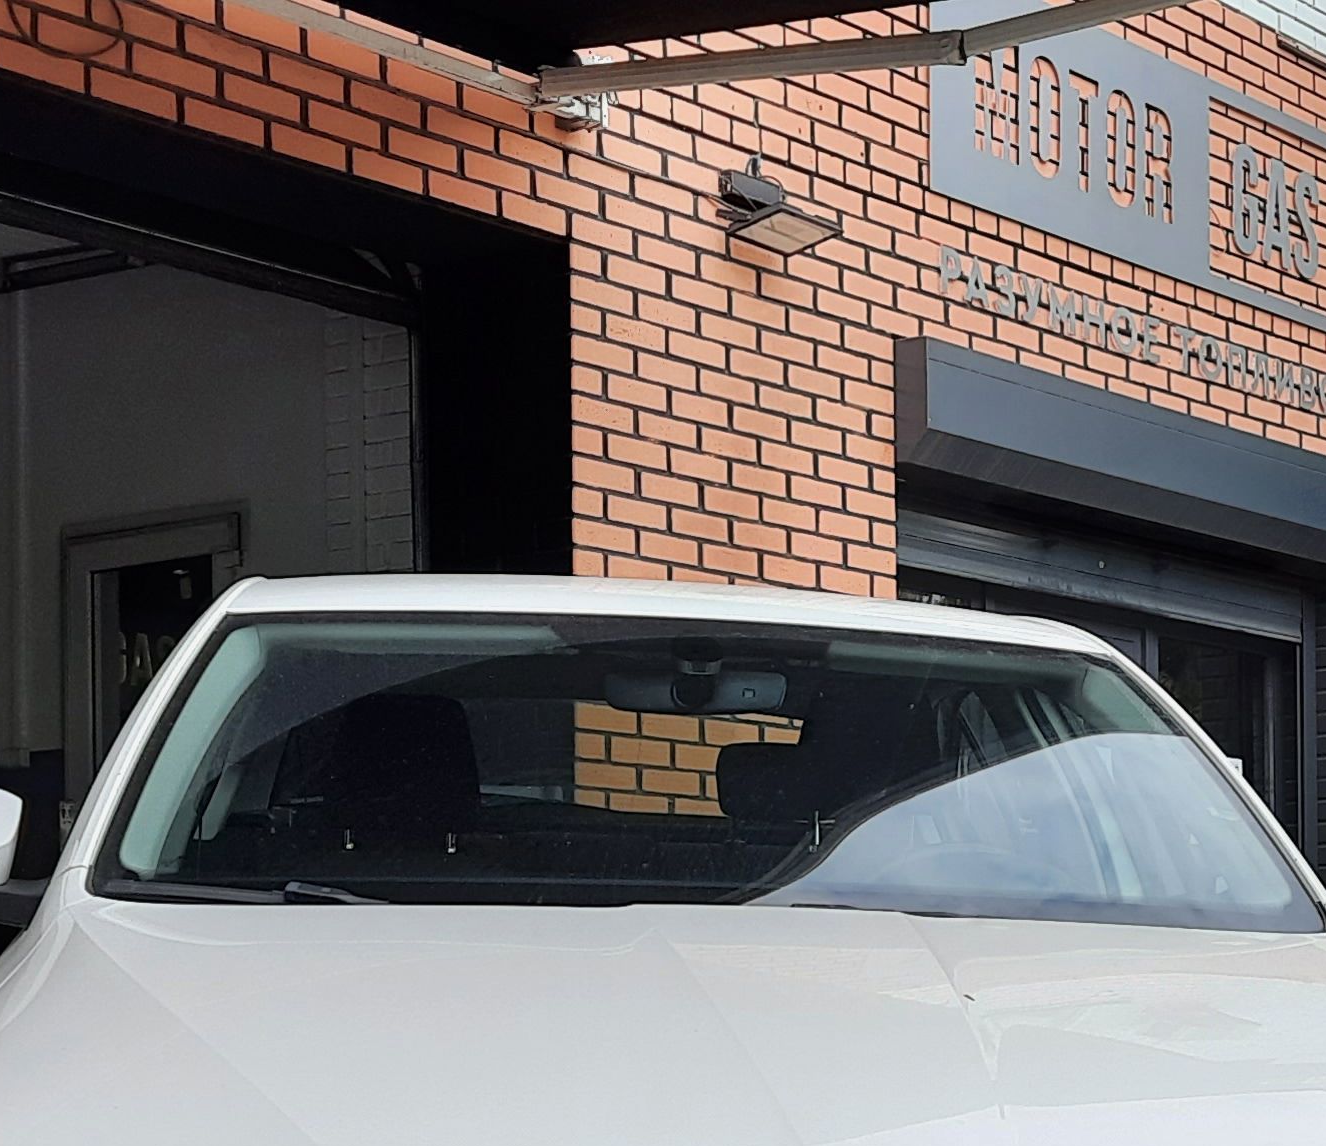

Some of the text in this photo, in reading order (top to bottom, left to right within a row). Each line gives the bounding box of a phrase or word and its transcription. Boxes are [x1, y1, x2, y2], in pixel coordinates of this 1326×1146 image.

[974, 45, 1320, 280] MOTOR GAS
[938, 244, 1163, 365] РАЗУМНОЕ
